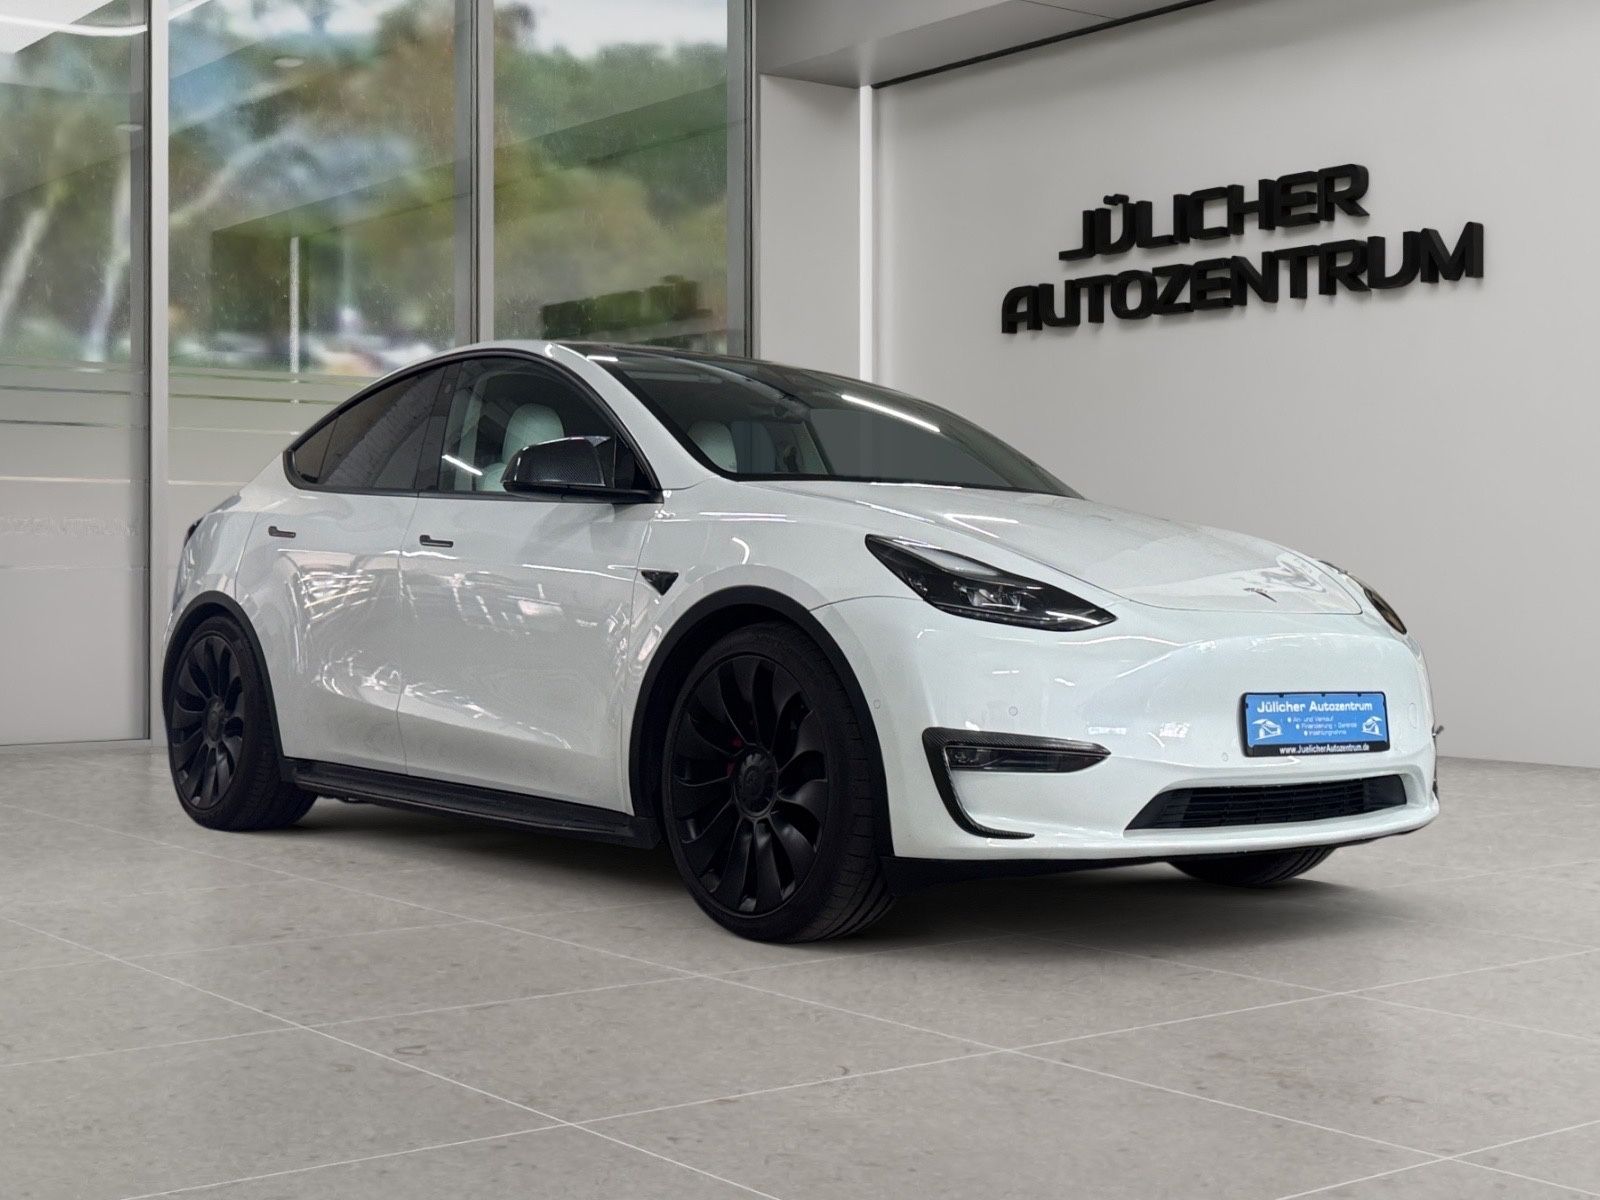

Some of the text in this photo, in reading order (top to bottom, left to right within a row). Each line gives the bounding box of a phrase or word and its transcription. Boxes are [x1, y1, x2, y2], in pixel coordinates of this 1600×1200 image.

[1059, 163, 1369, 261] JÜLICHER
[1001, 221, 1484, 334] AUTOZENTRUM
[1257, 701, 1373, 713] Jülicher Autozentrum
[1279, 743, 1370, 755] www.JuelicherAutozentrum.de
